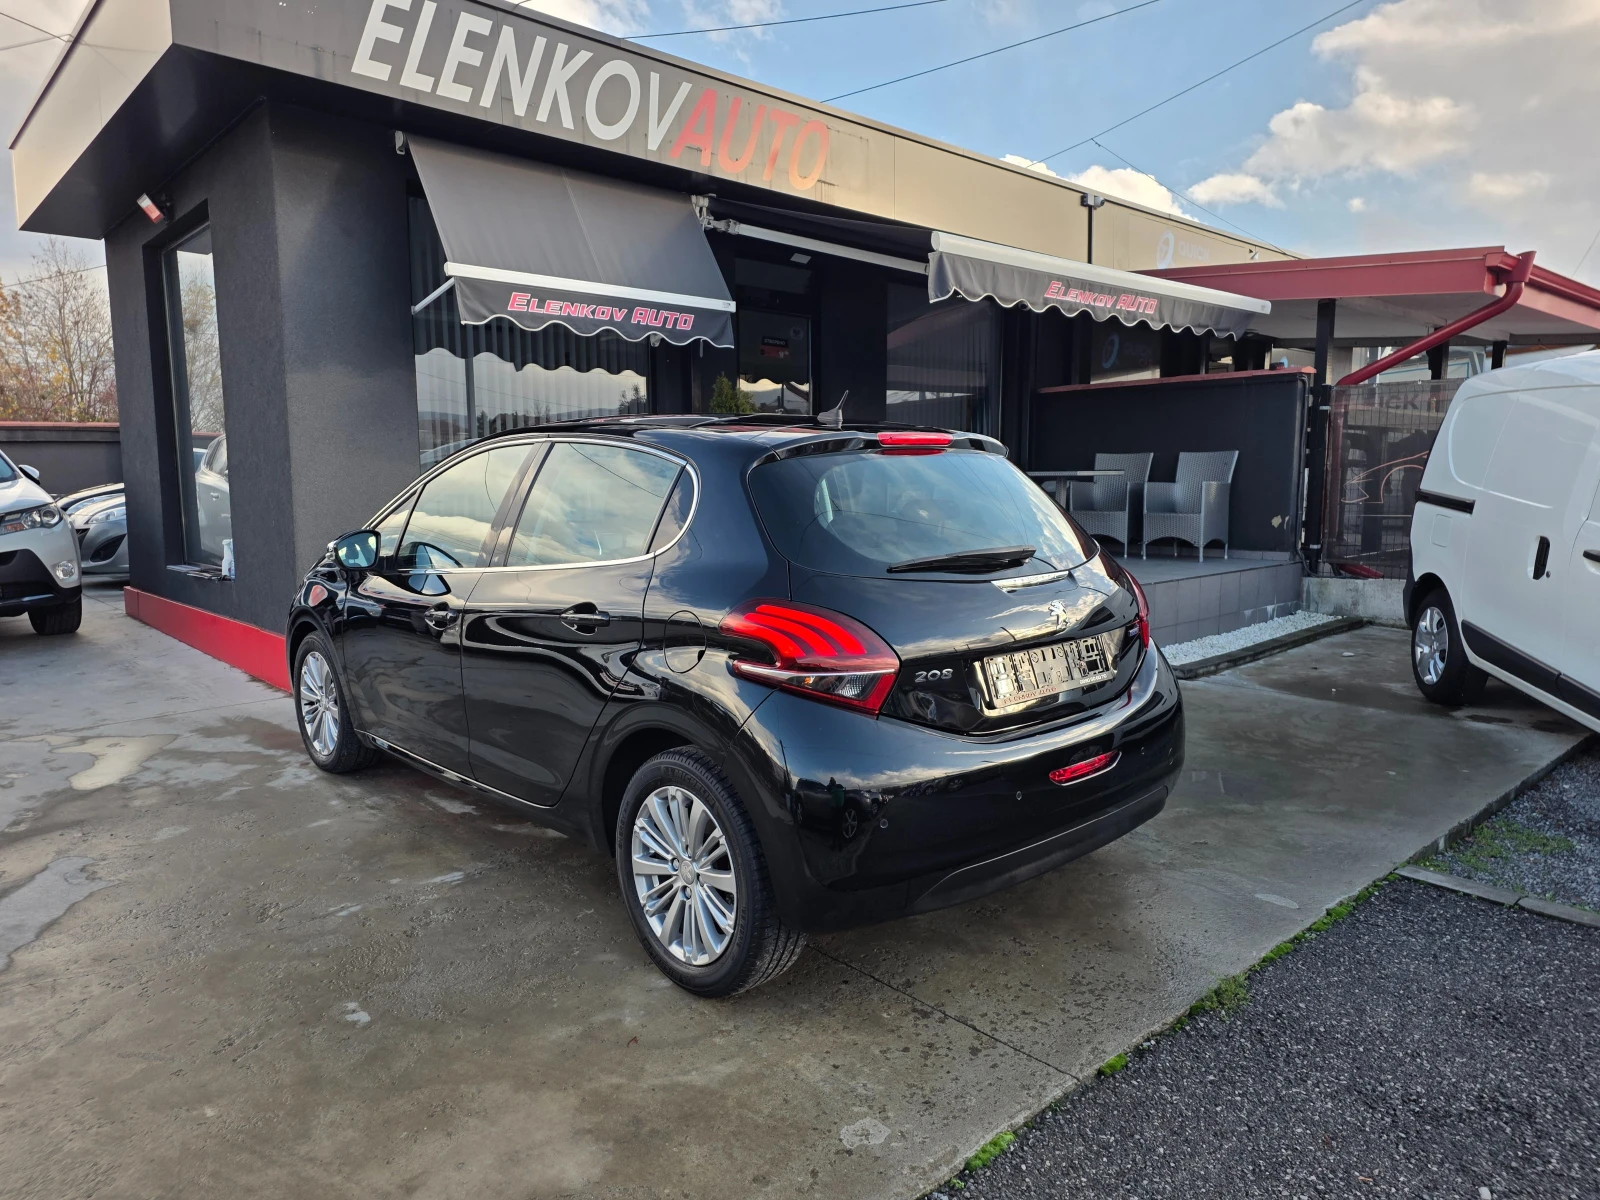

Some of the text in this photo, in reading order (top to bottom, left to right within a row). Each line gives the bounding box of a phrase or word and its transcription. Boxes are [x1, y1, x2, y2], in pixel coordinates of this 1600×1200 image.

[1178, 240, 1211, 262] QUICK
[507, 291, 695, 331] ELENKOV AUTO
[1044, 281, 1158, 315] ELENKOV AUTO
[914, 668, 954, 683] 208
[674, 769, 716, 805] MICHELIN
